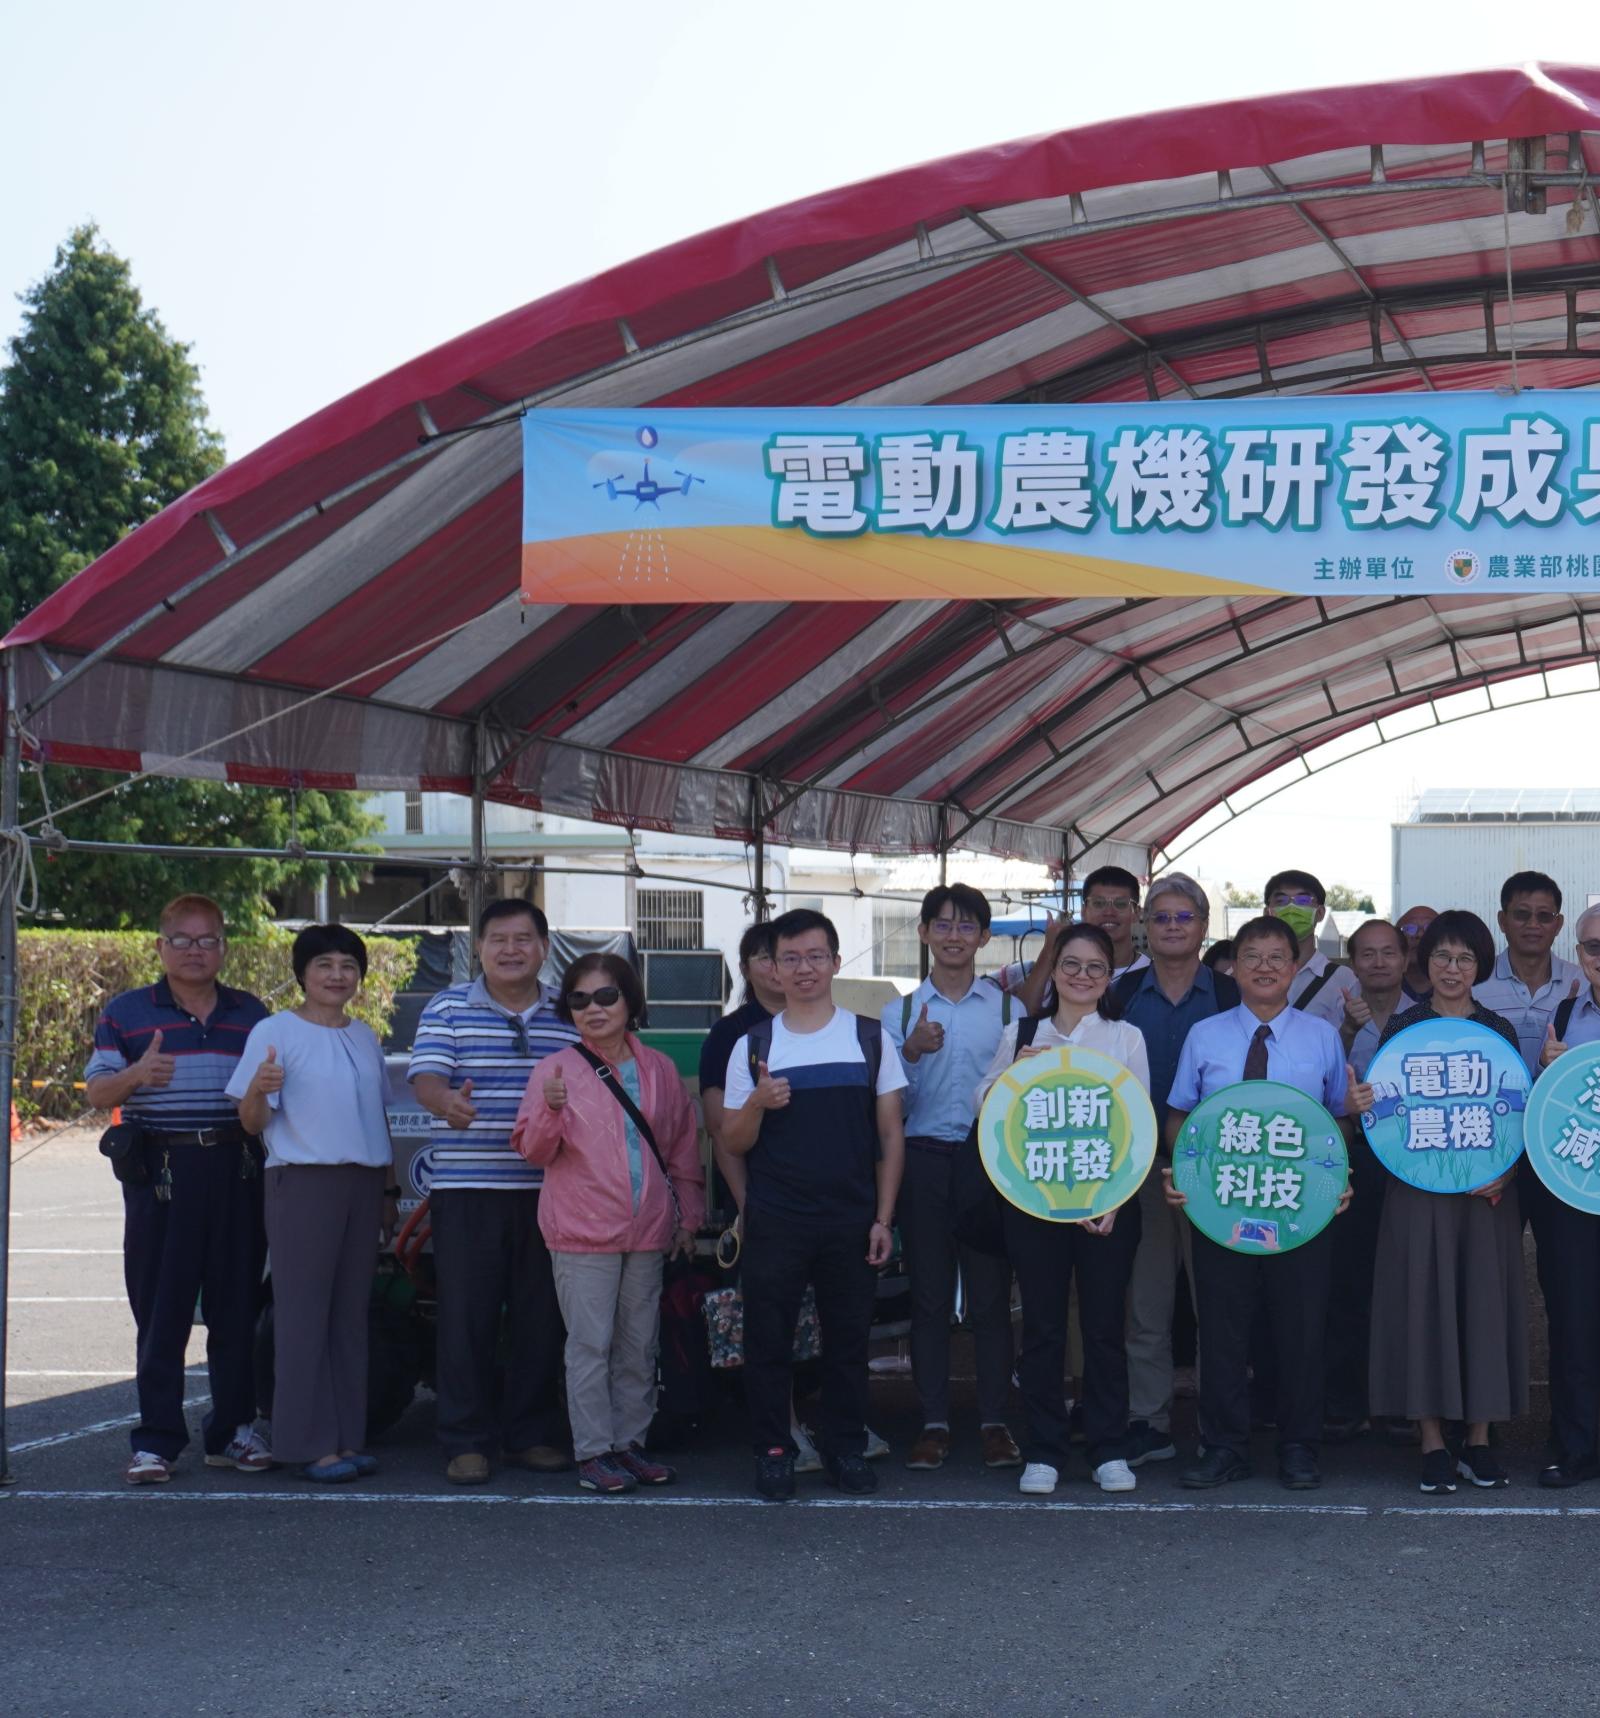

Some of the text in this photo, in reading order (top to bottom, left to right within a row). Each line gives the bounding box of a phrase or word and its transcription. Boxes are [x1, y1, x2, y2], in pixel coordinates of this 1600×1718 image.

[1312, 557, 1415, 581] 主辦單位
[1404, 1053, 1488, 1097] 電動
[1024, 1086, 1111, 1130] 創新
[1406, 1104, 1493, 1150] 農機
[1219, 1111, 1305, 1160] 綠色
[1024, 1138, 1112, 1182] 研發
[1216, 1164, 1302, 1211] 科技
